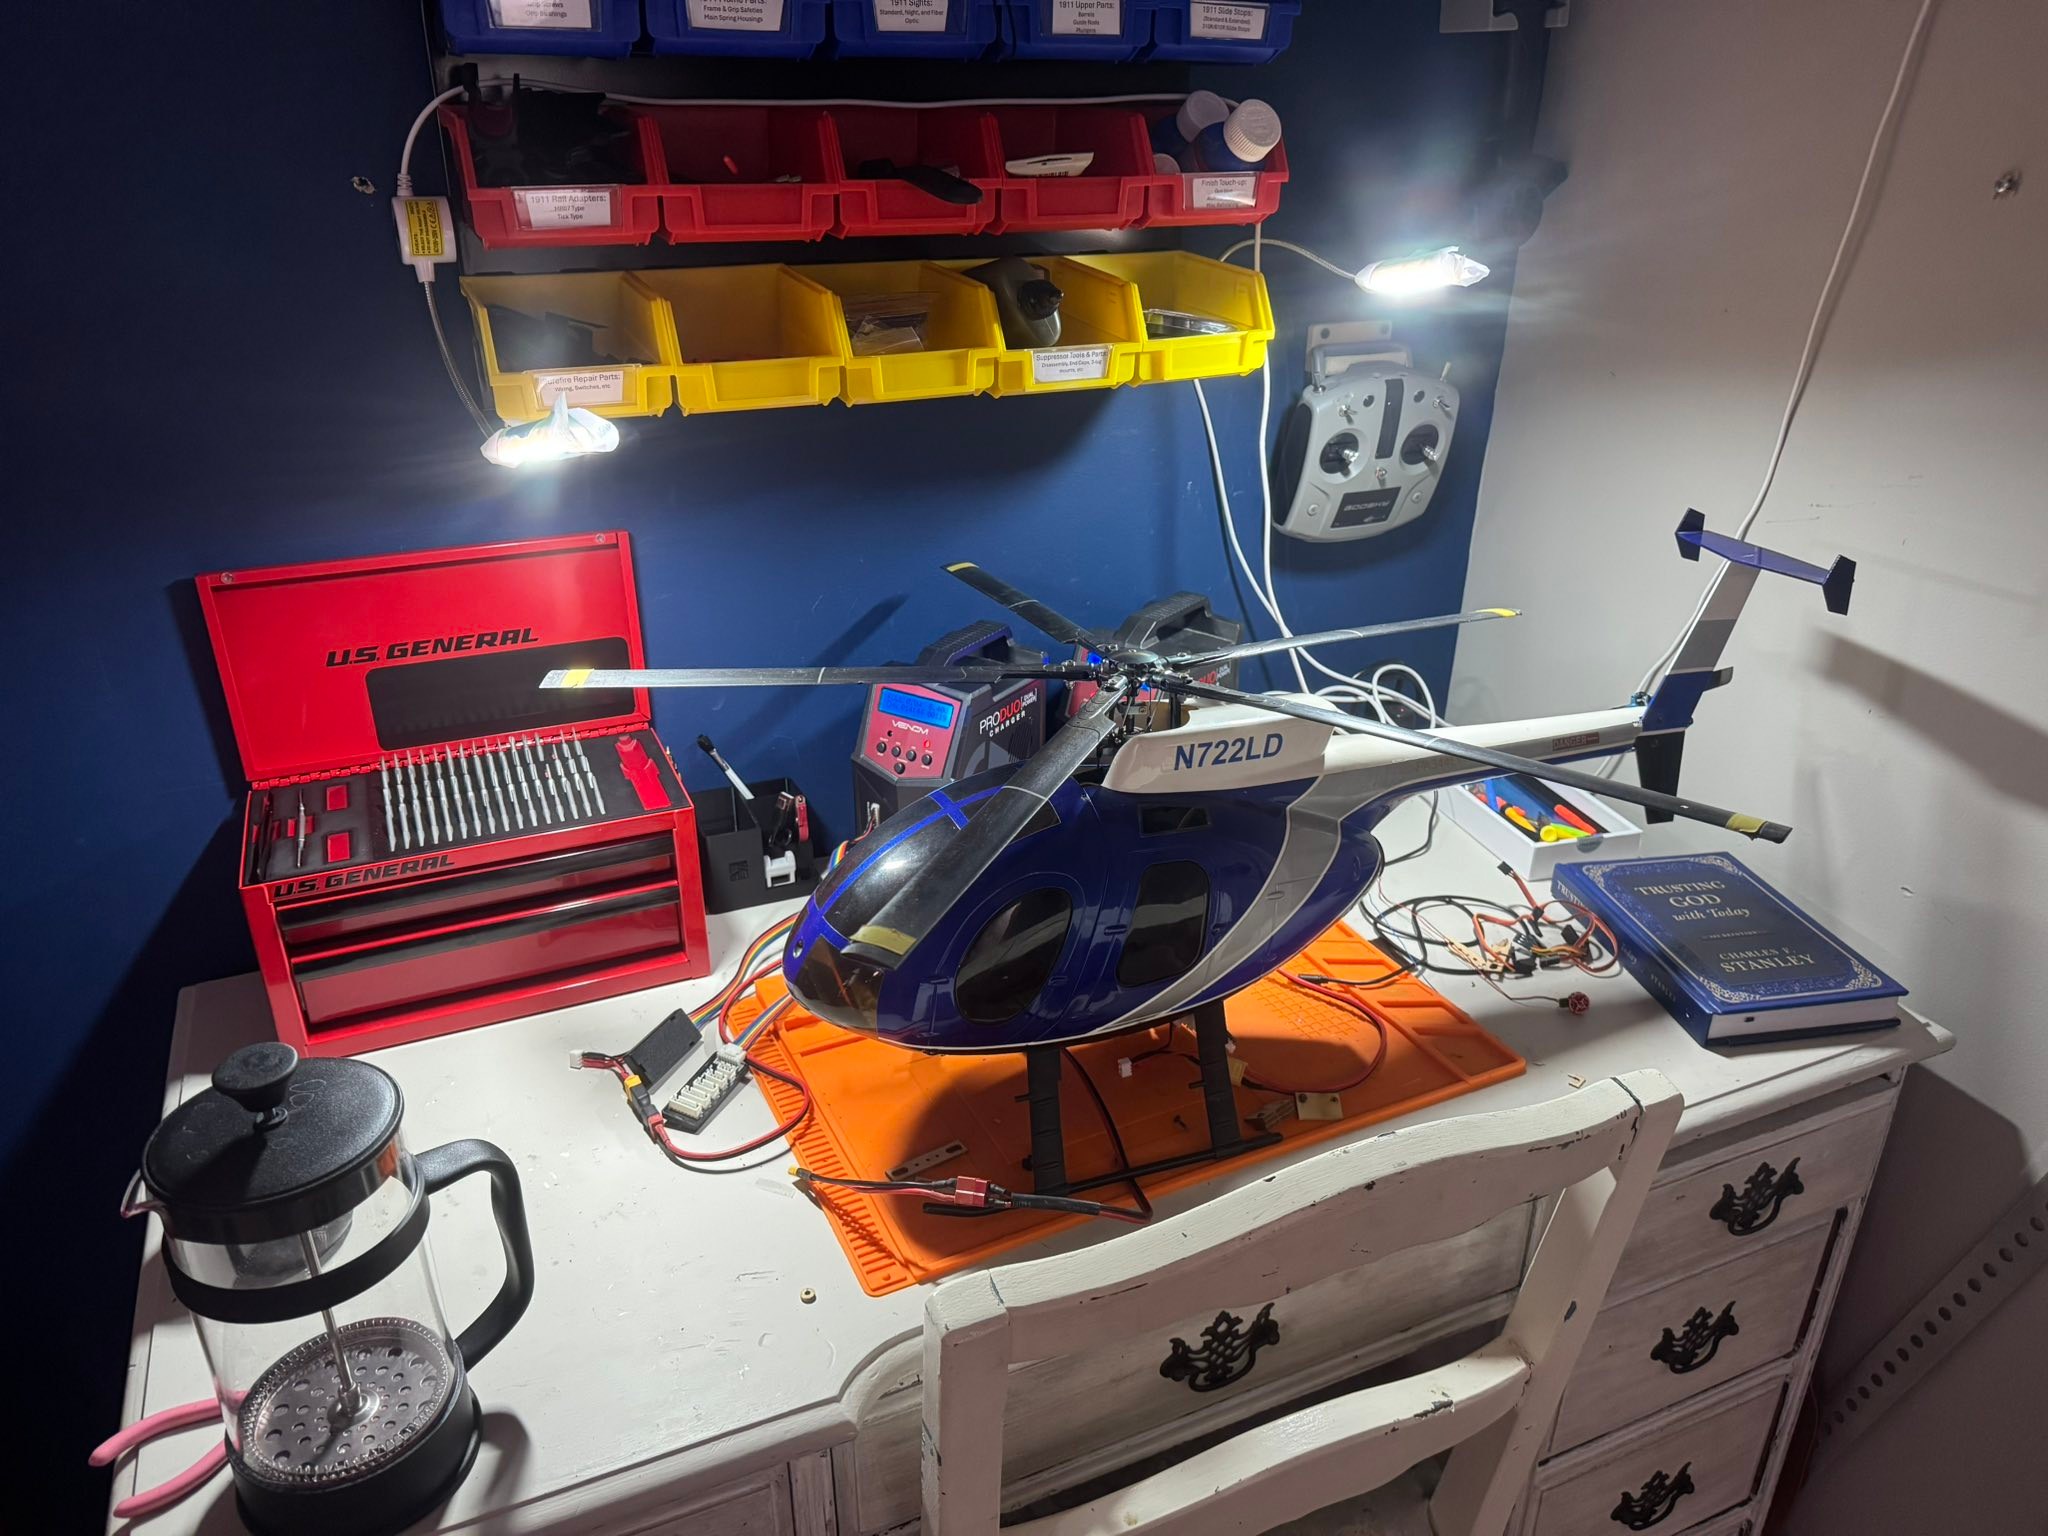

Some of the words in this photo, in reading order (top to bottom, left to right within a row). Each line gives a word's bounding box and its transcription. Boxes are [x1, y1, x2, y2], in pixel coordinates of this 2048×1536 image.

[1076, 1, 1095, 10] Upper
[1218, 7, 1232, 15] Slide
[531, 195, 550, 203] 1911
[1036, 353, 1069, 361] Suppressor
[573, 374, 597, 384] Repair
[599, 373, 621, 381] Parts:
[325, 645, 380, 667] U.S.
[386, 628, 539, 660] GENERAL
[891, 720, 929, 735] VENOM
[989, 710, 1026, 737] CHARGER
[1553, 735, 1587, 749] DANGER
[1174, 733, 1283, 770] N722LD
[274, 879, 320, 898] U.S.
[325, 855, 455, 888] GENERAL
[1634, 880, 1725, 896] TRUSTING
[1669, 894, 1721, 908] GOD
[1672, 910, 1706, 922] with
[1706, 907, 1751, 918] Today
[1719, 948, 1779, 960] CHARLES
[1720, 953, 1816, 973] STANLEY
